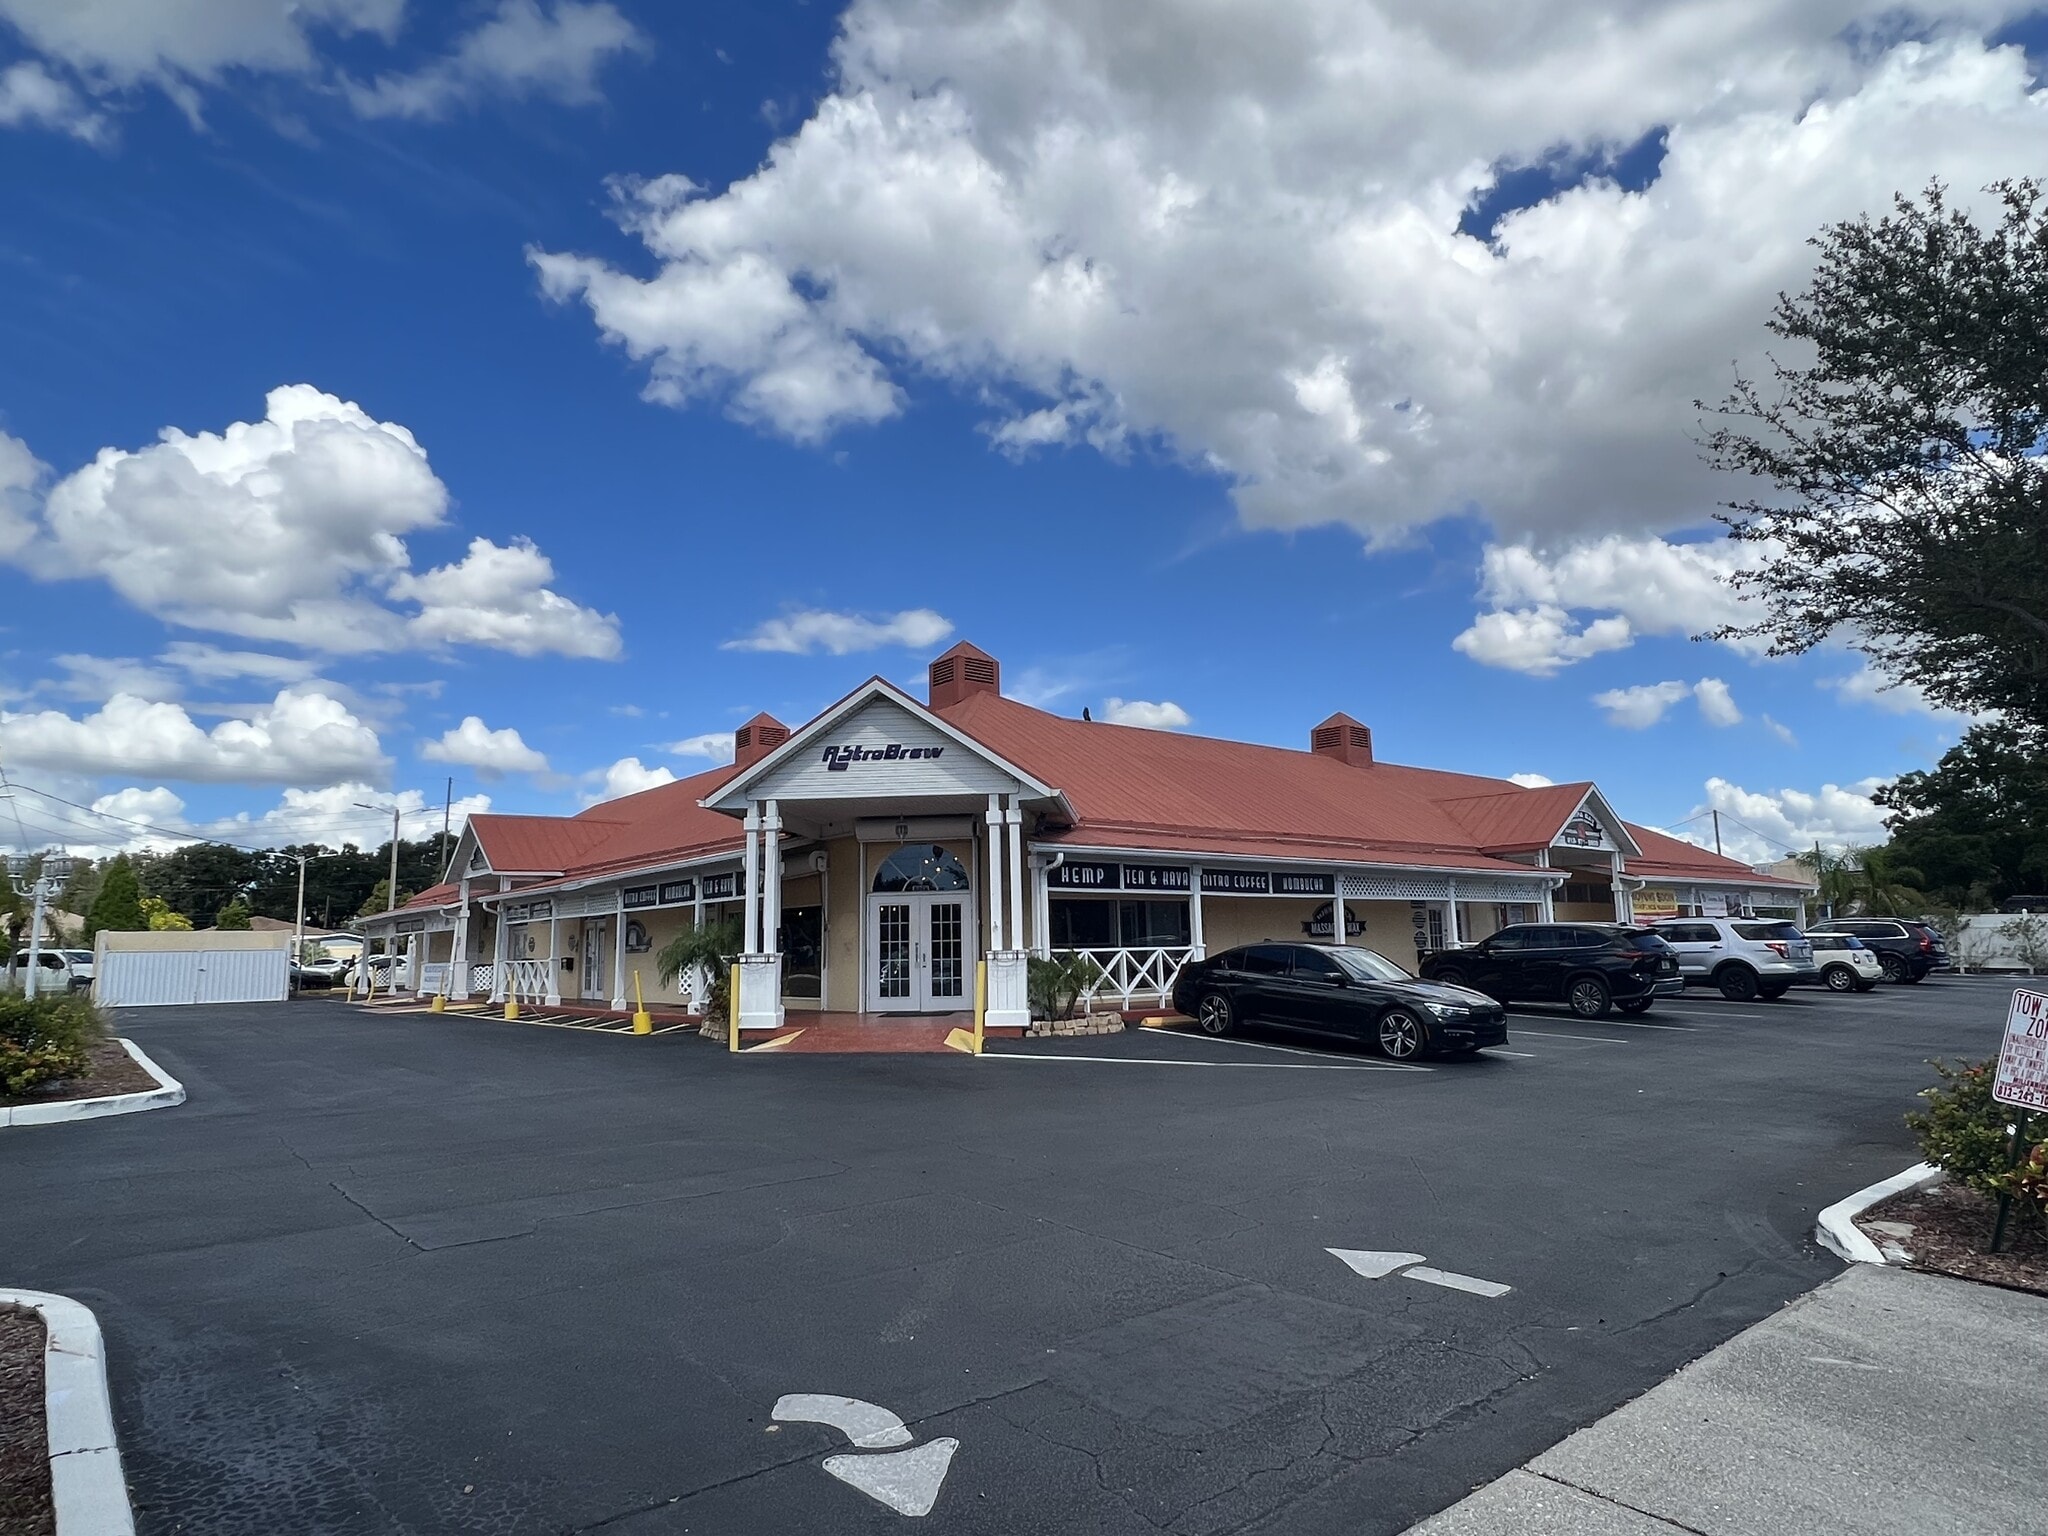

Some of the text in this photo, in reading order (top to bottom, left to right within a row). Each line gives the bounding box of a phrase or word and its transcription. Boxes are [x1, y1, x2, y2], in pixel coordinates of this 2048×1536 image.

[1061, 866, 1105, 884] HEMP
[1125, 869, 1189, 887] TEA & KAVA
[1203, 874, 1266, 889] NITRO COFFEE
[1283, 877, 1324, 891] KOMBUCHA
[2016, 993, 2043, 1017] TOW
